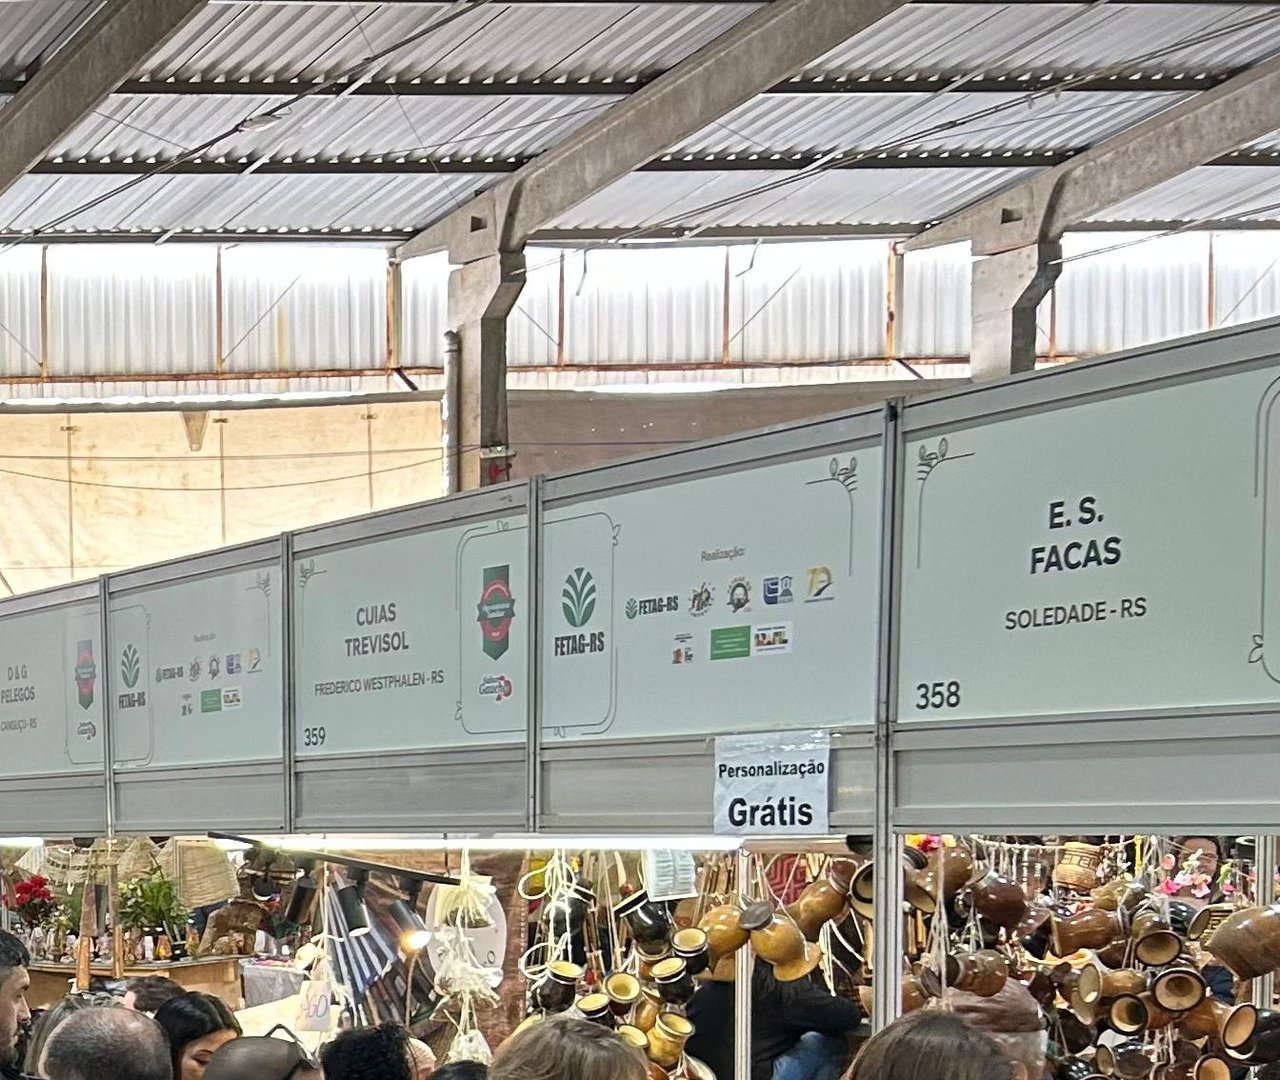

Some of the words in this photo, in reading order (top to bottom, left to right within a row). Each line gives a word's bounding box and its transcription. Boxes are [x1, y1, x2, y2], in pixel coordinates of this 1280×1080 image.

[1029, 536, 1122, 574] FACAS
[356, 602, 397, 626] CUIAS
[638, 595, 679, 616] FETAG-RS
[1005, 601, 1107, 630] SOLEDADE
[1120, 596, 1147, 618] RS
[345, 631, 409, 657] TREVISOL
[554, 631, 605, 657] FETAG-RS
[1, 686, 36, 704] PELEGOS
[314, 678, 362, 696] FREDERICO
[363, 671, 426, 692] WESTPHALEN
[431, 670, 445, 685] RS
[915, 680, 961, 710] 358
[304, 726, 326, 746] 359
[718, 759, 825, 779] Personalização
[728, 796, 813, 827] Grátis
